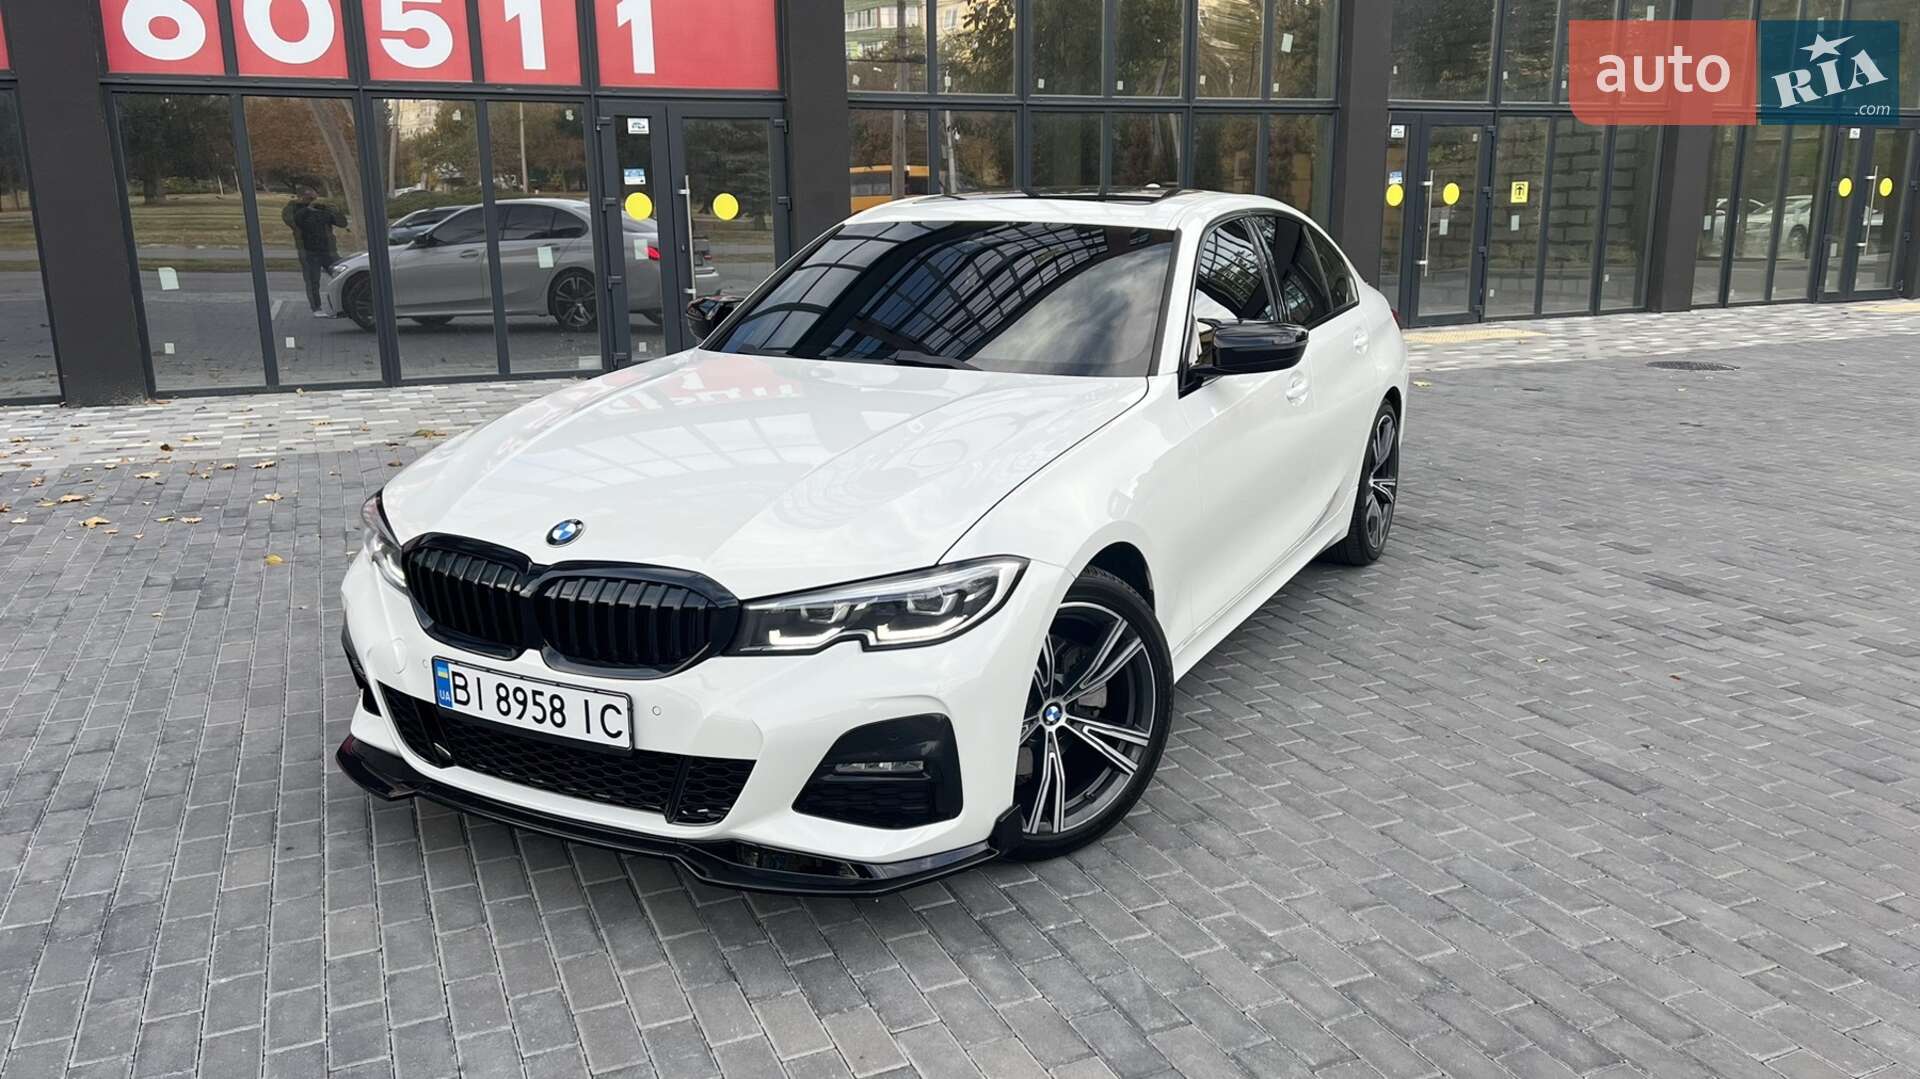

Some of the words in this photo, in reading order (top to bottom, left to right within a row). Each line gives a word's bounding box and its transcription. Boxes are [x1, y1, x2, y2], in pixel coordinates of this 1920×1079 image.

[439, 689, 451, 701] UA
[451, 670, 484, 711] BI
[495, 682, 567, 728] 8958
[584, 698, 624, 739] IC
